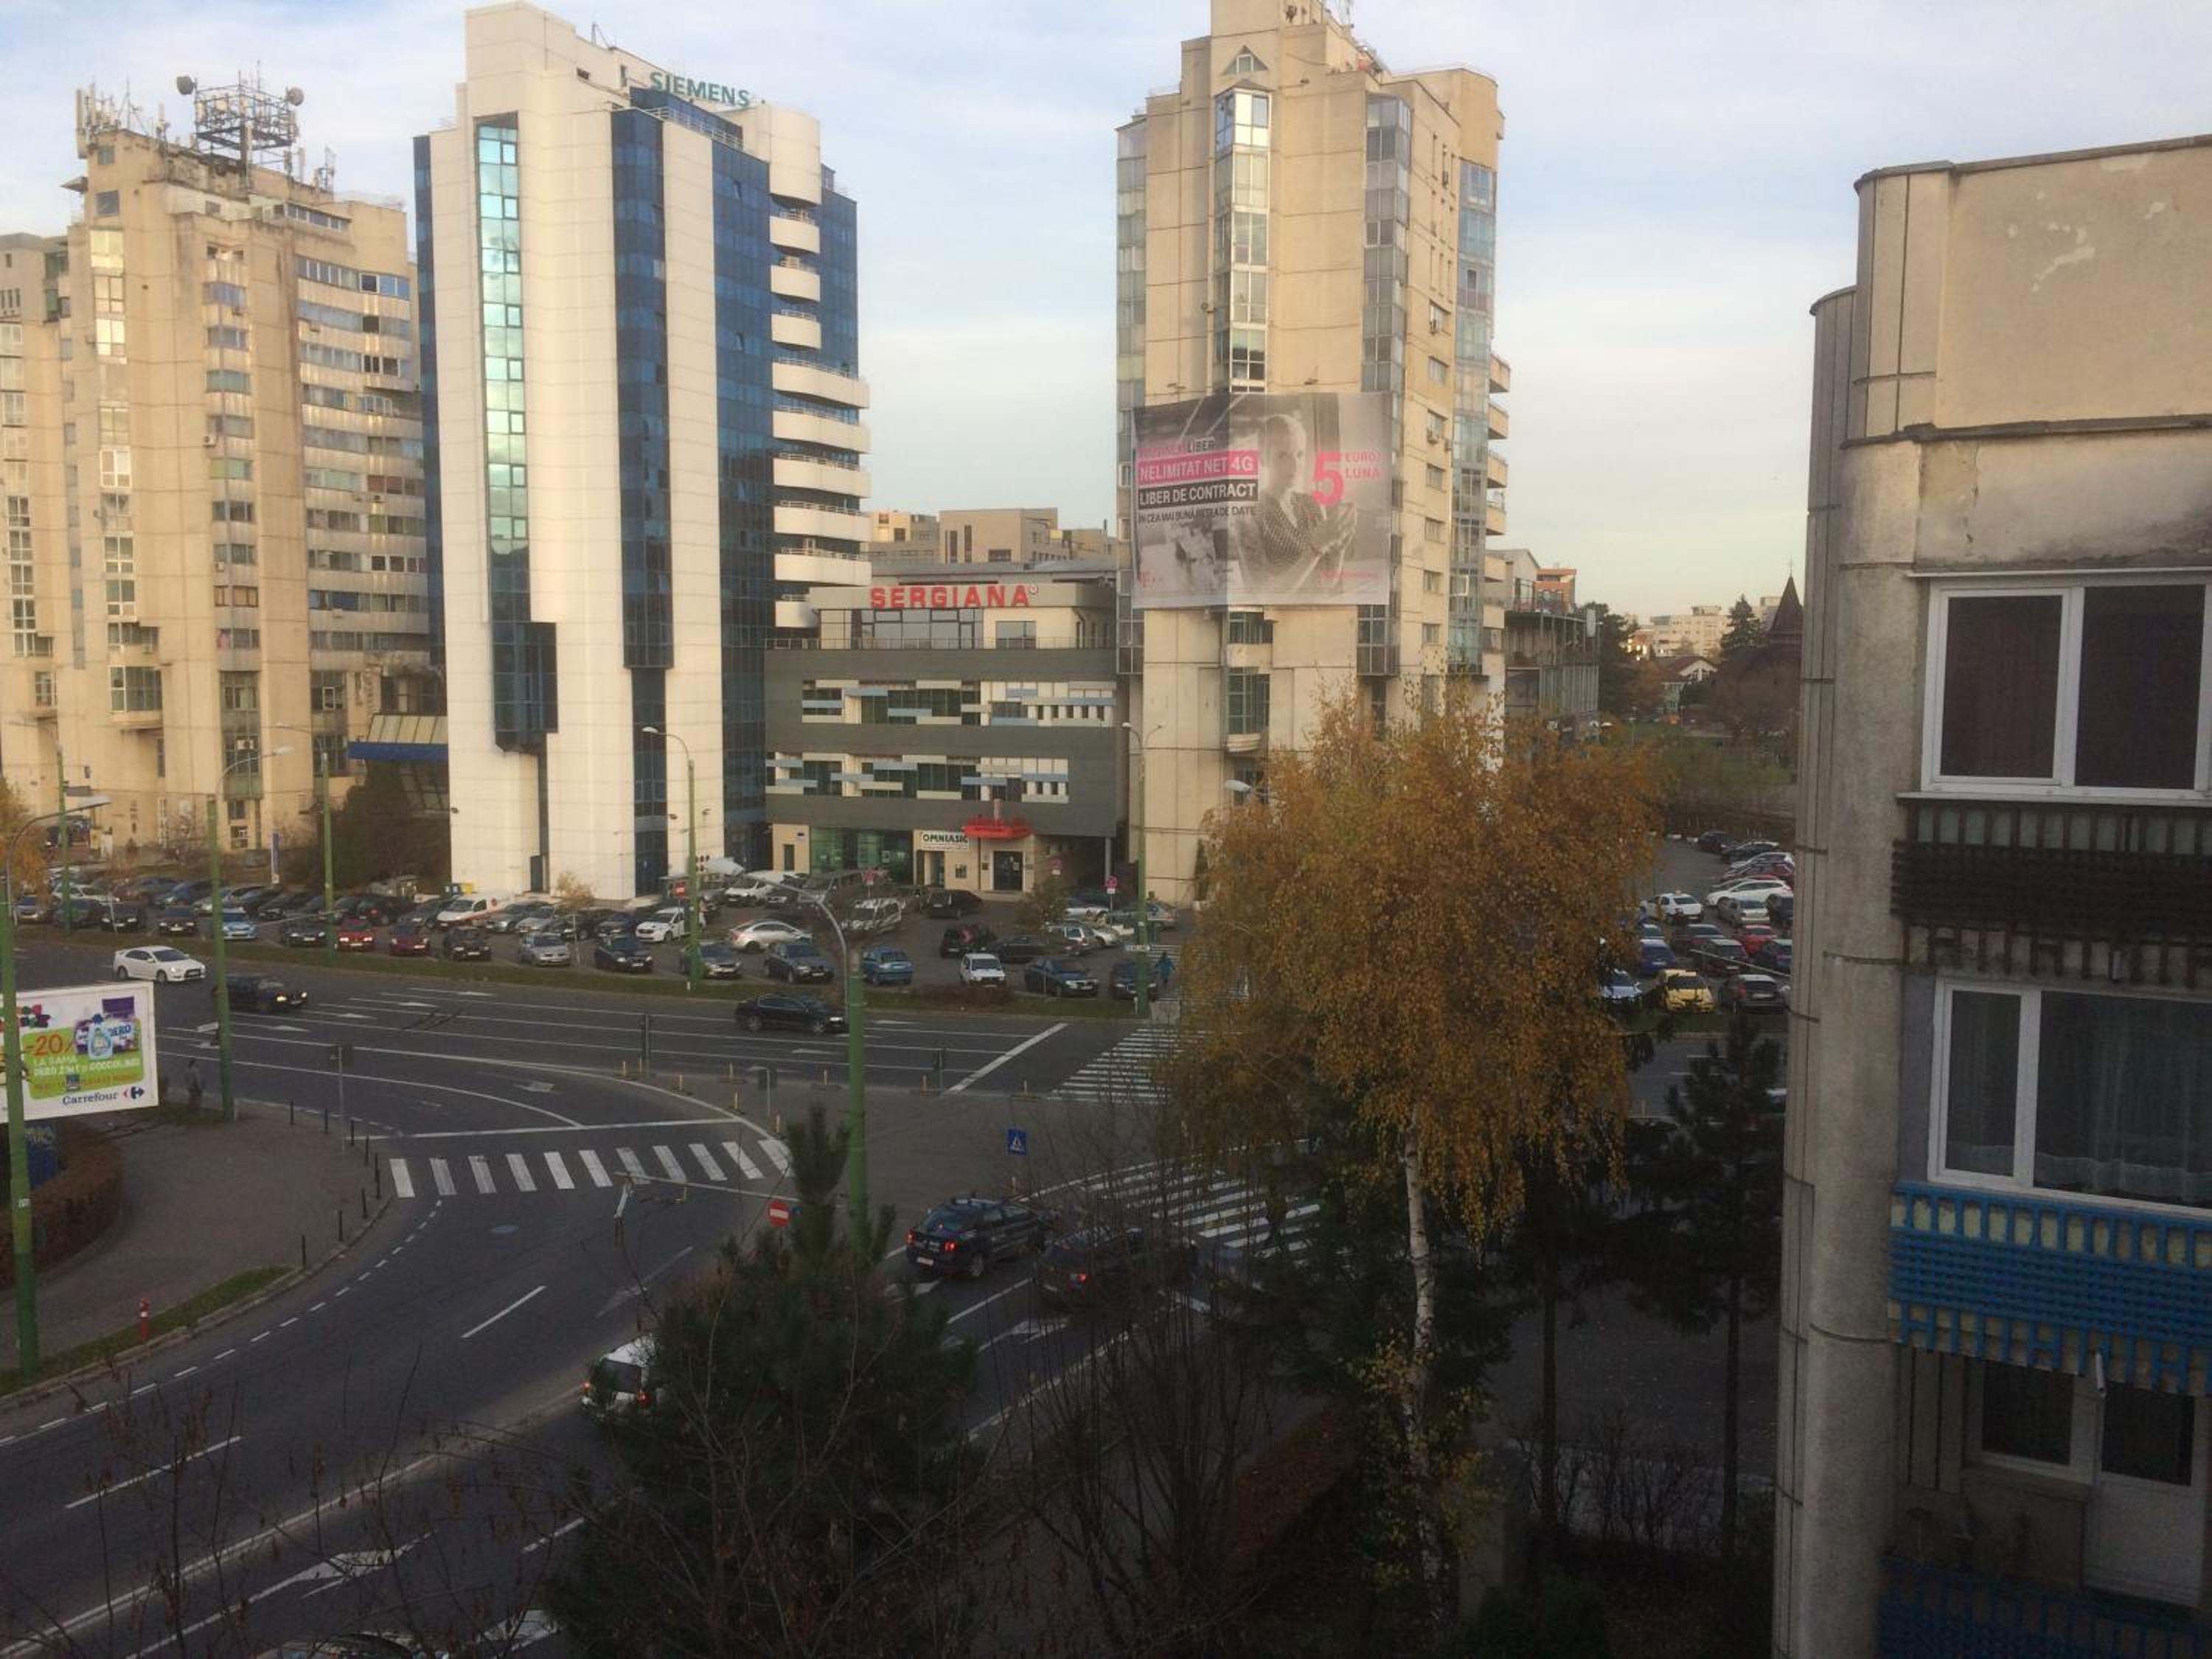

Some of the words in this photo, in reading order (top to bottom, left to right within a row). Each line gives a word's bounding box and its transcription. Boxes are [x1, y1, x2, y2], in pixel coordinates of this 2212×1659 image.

[650, 72, 750, 107] SIEMENS
[1140, 460, 1203, 480] NELIMITAT
[1204, 457, 1228, 473] NET
[1230, 455, 1253, 472] 4G
[1312, 451, 1344, 507] 5
[1139, 490, 1170, 506] LIBER
[1172, 487, 1187, 502] DE
[1189, 483, 1256, 501] CONTRACT
[871, 584, 1030, 610] SERGIANA
[62, 1090, 118, 1105] Carrefour
